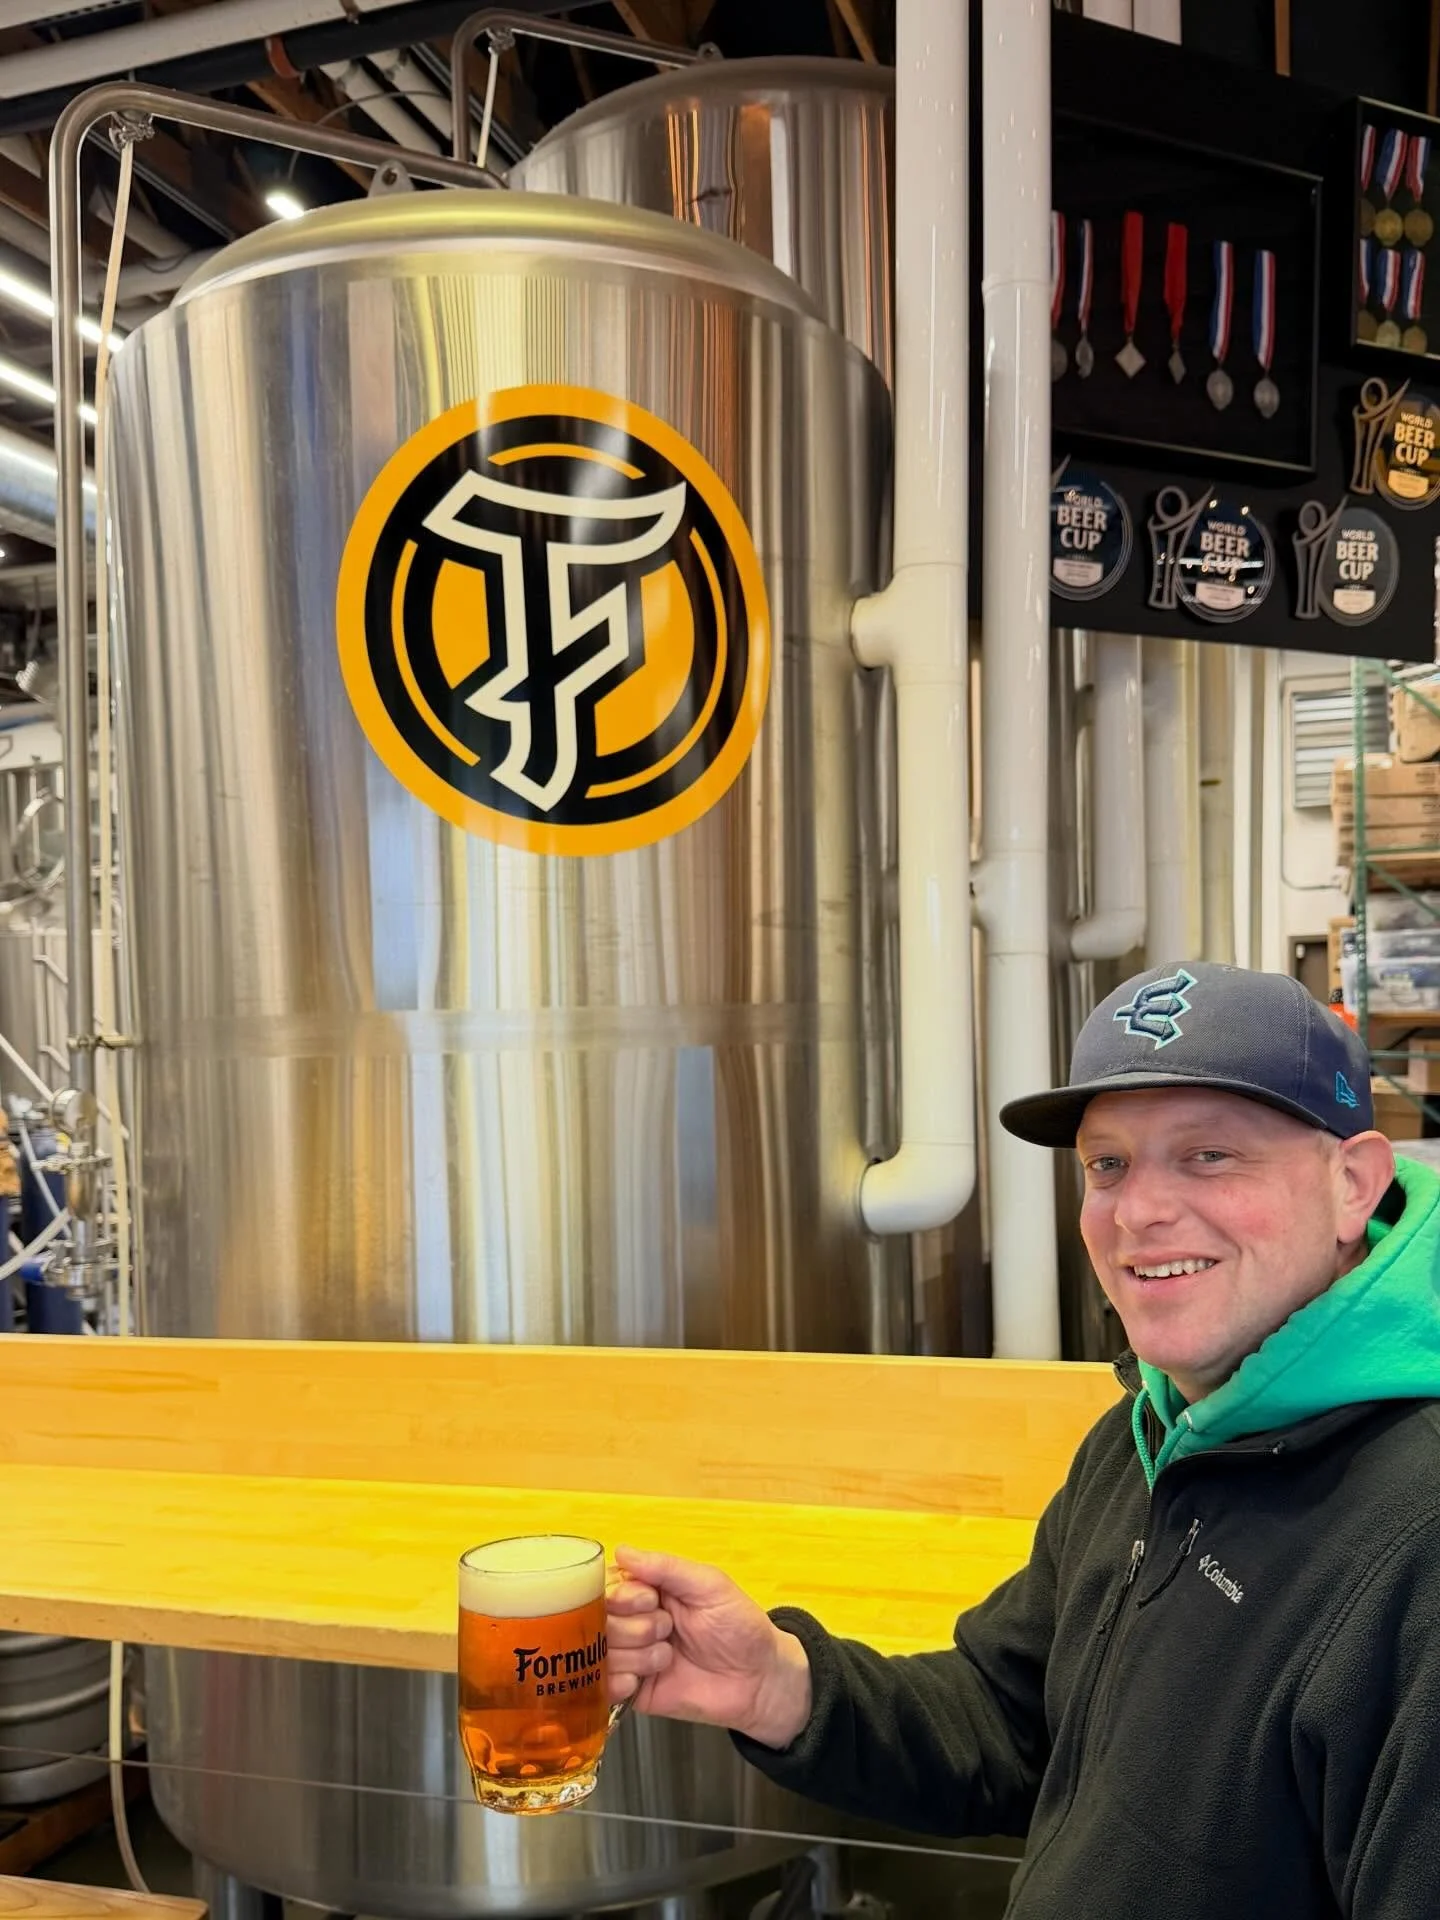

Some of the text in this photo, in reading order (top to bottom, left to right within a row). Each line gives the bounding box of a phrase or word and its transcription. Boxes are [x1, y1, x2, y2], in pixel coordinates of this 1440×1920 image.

[1401, 412, 1433, 428] WORLD
[1394, 422, 1435, 449] BEER
[1395, 442, 1429, 466] CUP
[1057, 505, 1107, 531] BEER
[1208, 520, 1246, 536] WORLD
[1060, 526, 1102, 551] CUP
[1201, 532, 1250, 557] BEER
[1341, 529, 1375, 541] WORLD
[1336, 541, 1378, 561] BEER
[1339, 560, 1374, 580] CUP
[1204, 1560, 1244, 1603] Columbia
[536, 1668, 601, 1696] BREWING
